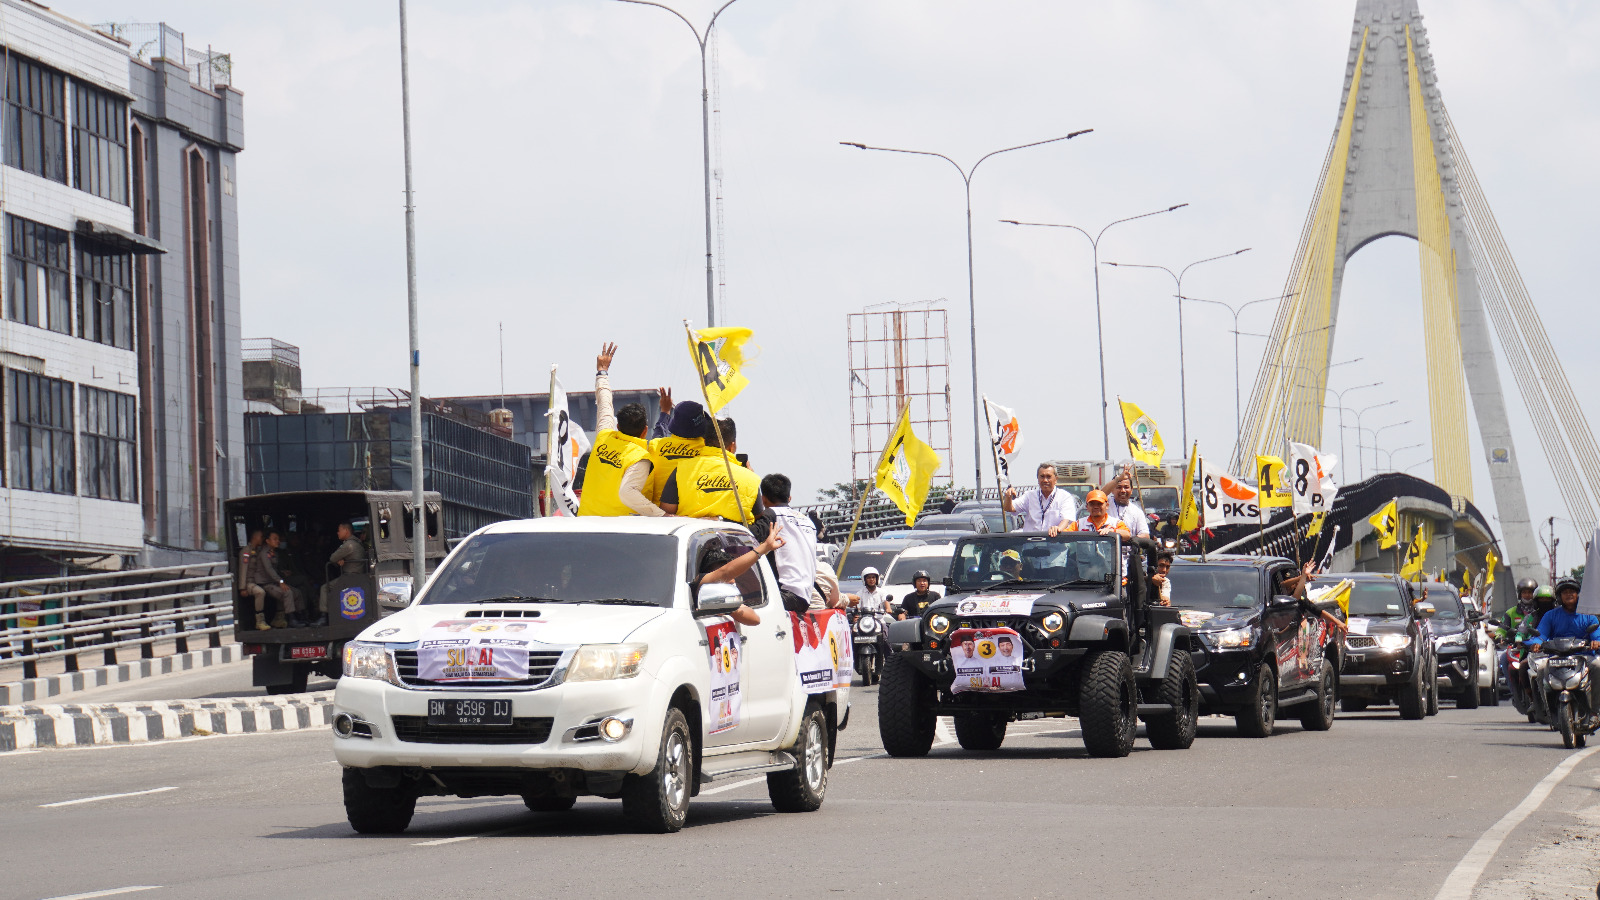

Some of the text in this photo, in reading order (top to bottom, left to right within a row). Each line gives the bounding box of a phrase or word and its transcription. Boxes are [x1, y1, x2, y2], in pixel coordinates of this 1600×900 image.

[698, 341, 725, 391] 4
[659, 442, 700, 457] Golkar
[696, 474, 738, 490] Golka
[1260, 464, 1273, 498] 4
[1295, 458, 1309, 496] 8
[1205, 474, 1218, 509] 8
[1222, 503, 1260, 518] PKS
[982, 643, 992, 655] 3
[431, 701, 508, 716] BM 9596 DJ
